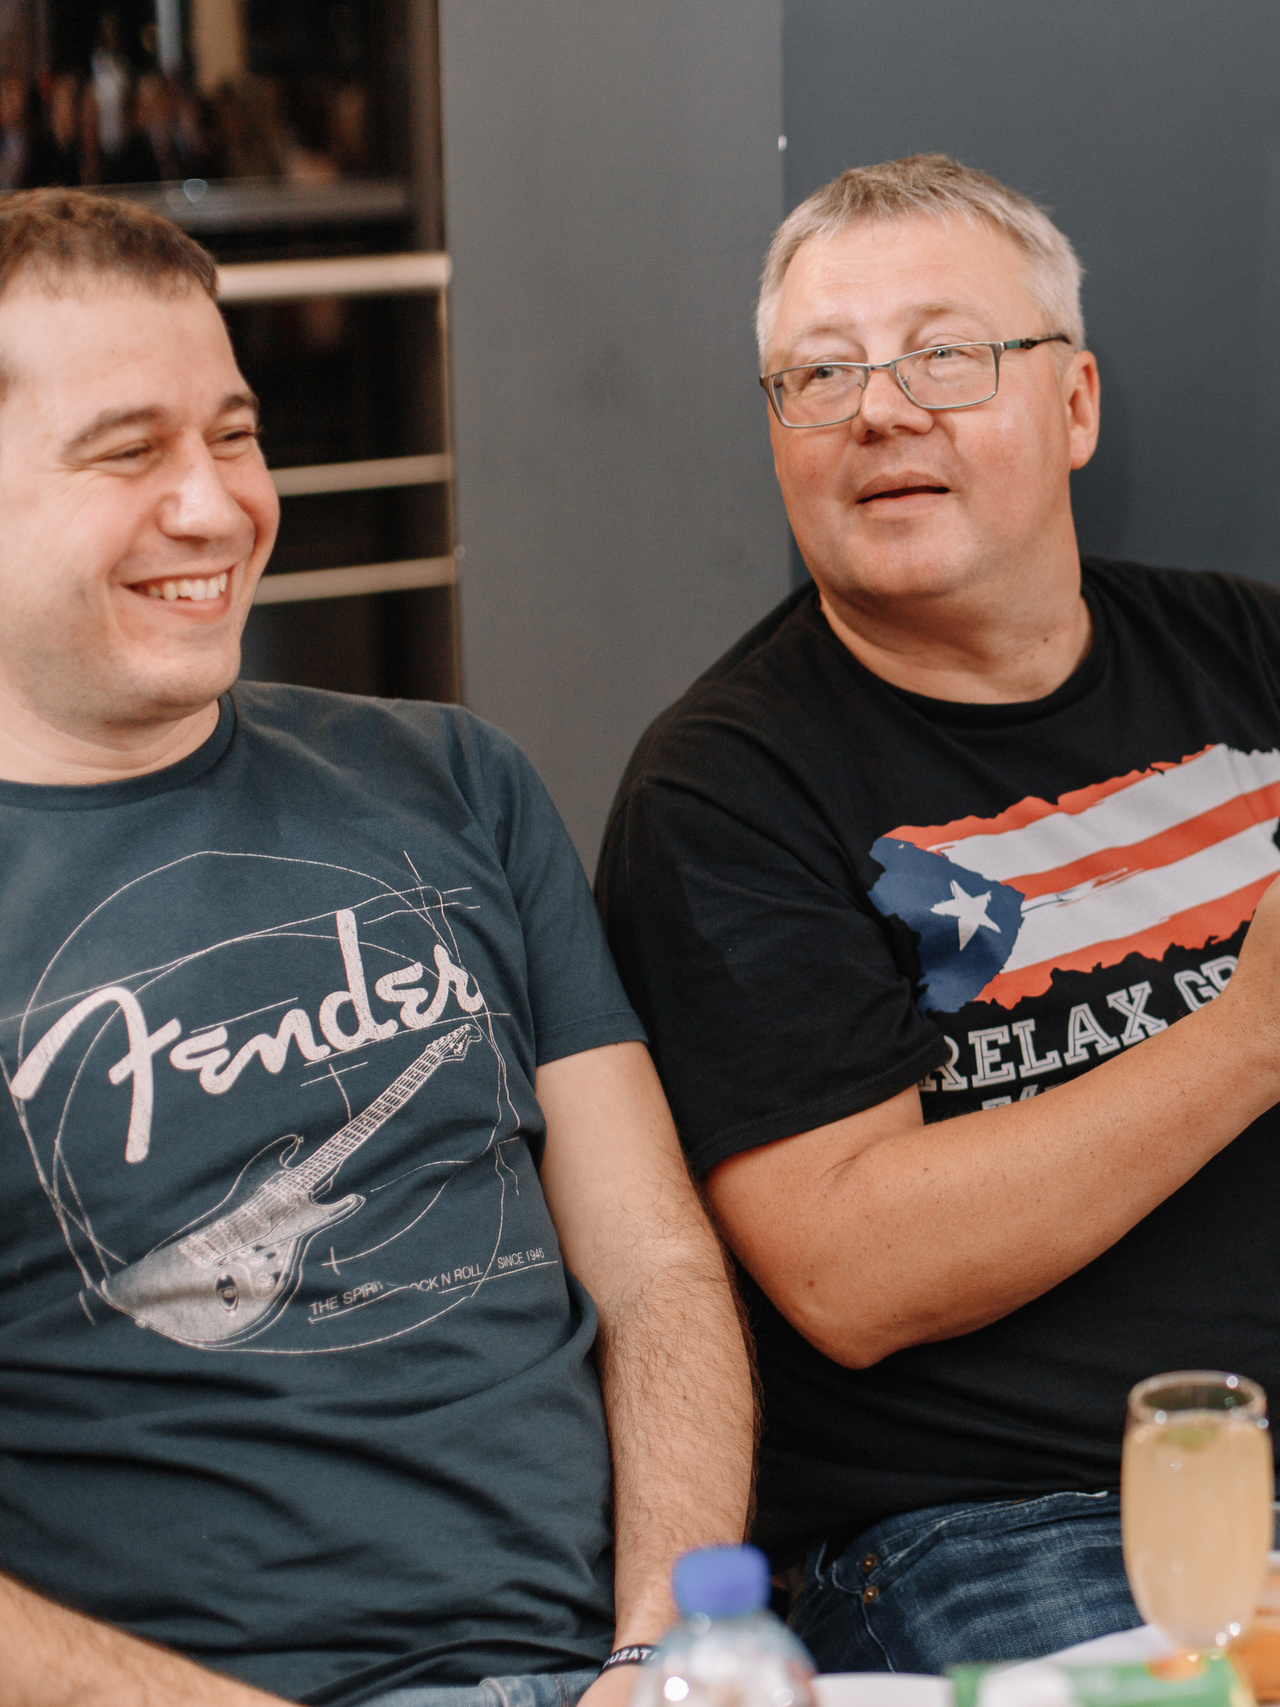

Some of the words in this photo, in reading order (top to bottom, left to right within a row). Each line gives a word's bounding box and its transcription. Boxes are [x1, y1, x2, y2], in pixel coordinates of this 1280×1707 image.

[10, 909, 484, 1163] Fender
[919, 981, 1169, 1091] RELAX
[309, 1298, 339, 1315] THE
[441, 1273, 451, 1287] N
[453, 1263, 484, 1282] ROLL
[497, 1252, 524, 1269] SINCE
[526, 1247, 545, 1261] 1946
